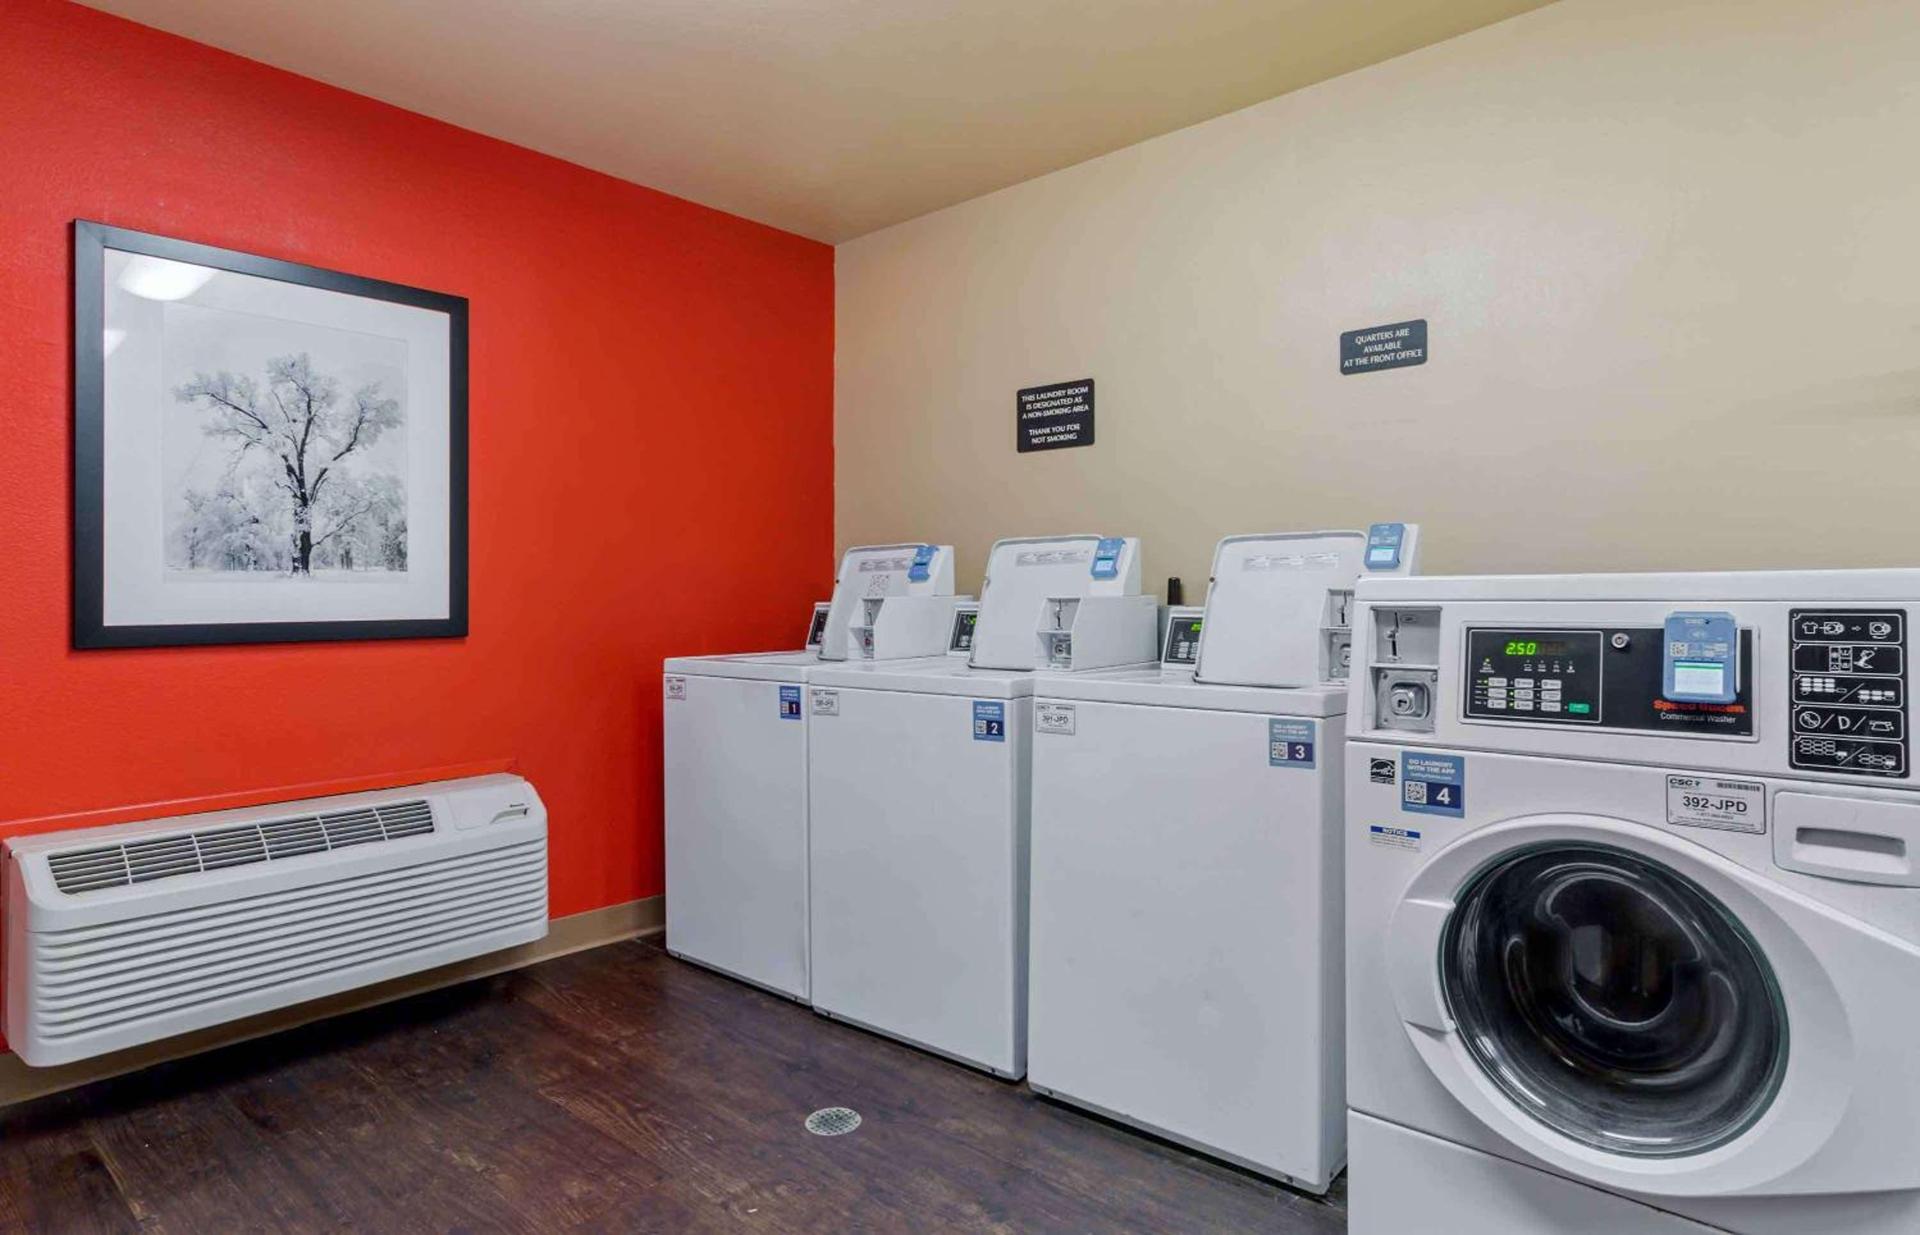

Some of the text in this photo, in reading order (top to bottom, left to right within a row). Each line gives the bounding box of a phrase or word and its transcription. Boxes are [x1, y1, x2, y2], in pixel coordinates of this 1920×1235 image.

[1355, 328, 1410, 345] QUARTERS ARE
[1363, 341, 1402, 353] AVAILABLE
[1343, 349, 1423, 368] AT THE FRONT OFFICE
[1036, 390, 1067, 399] LAUNDRY
[1067, 386, 1088, 395] ROOM
[1026, 396, 1083, 410] IS DESIGNATED AS
[1028, 407, 1072, 418] NON-SMOKING
[1072, 404, 1089, 413] AREA
[1029, 427, 1051, 436] THANK
[1066, 423, 1080, 431] FOR
[1031, 433, 1077, 444] NOT SMOKING
[1506, 642, 1537, 656] 2.50
[991, 723, 998, 734] 2
[1295, 745, 1305, 759] 3
[1436, 787, 1451, 805] 4
[1683, 796, 1747, 812] 392-JPD
